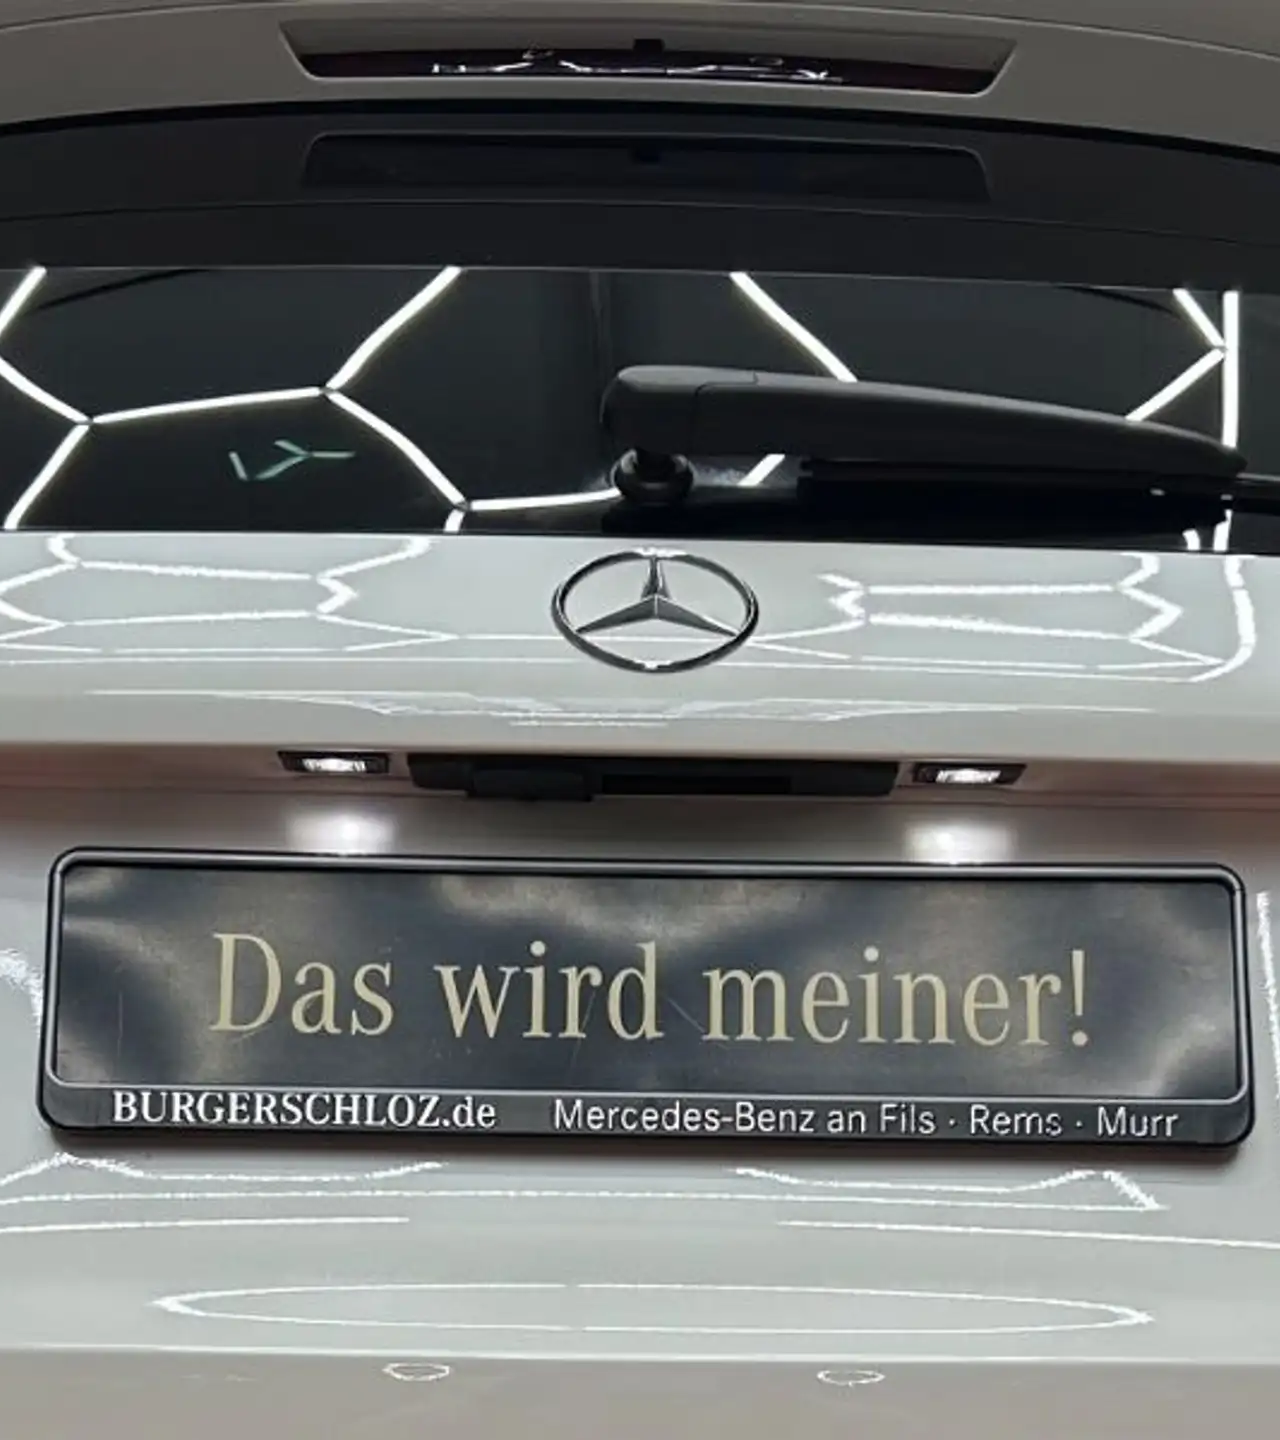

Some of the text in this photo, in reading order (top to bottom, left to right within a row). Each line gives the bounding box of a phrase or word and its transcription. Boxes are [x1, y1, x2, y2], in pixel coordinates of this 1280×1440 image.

[208, 932, 1090, 1048] Das wird meiner!
[111, 1090, 498, 1129] BURGERSCHLOZ.de
[552, 1099, 1180, 1138] Mercedes-Benz an Fils Rems Murr
